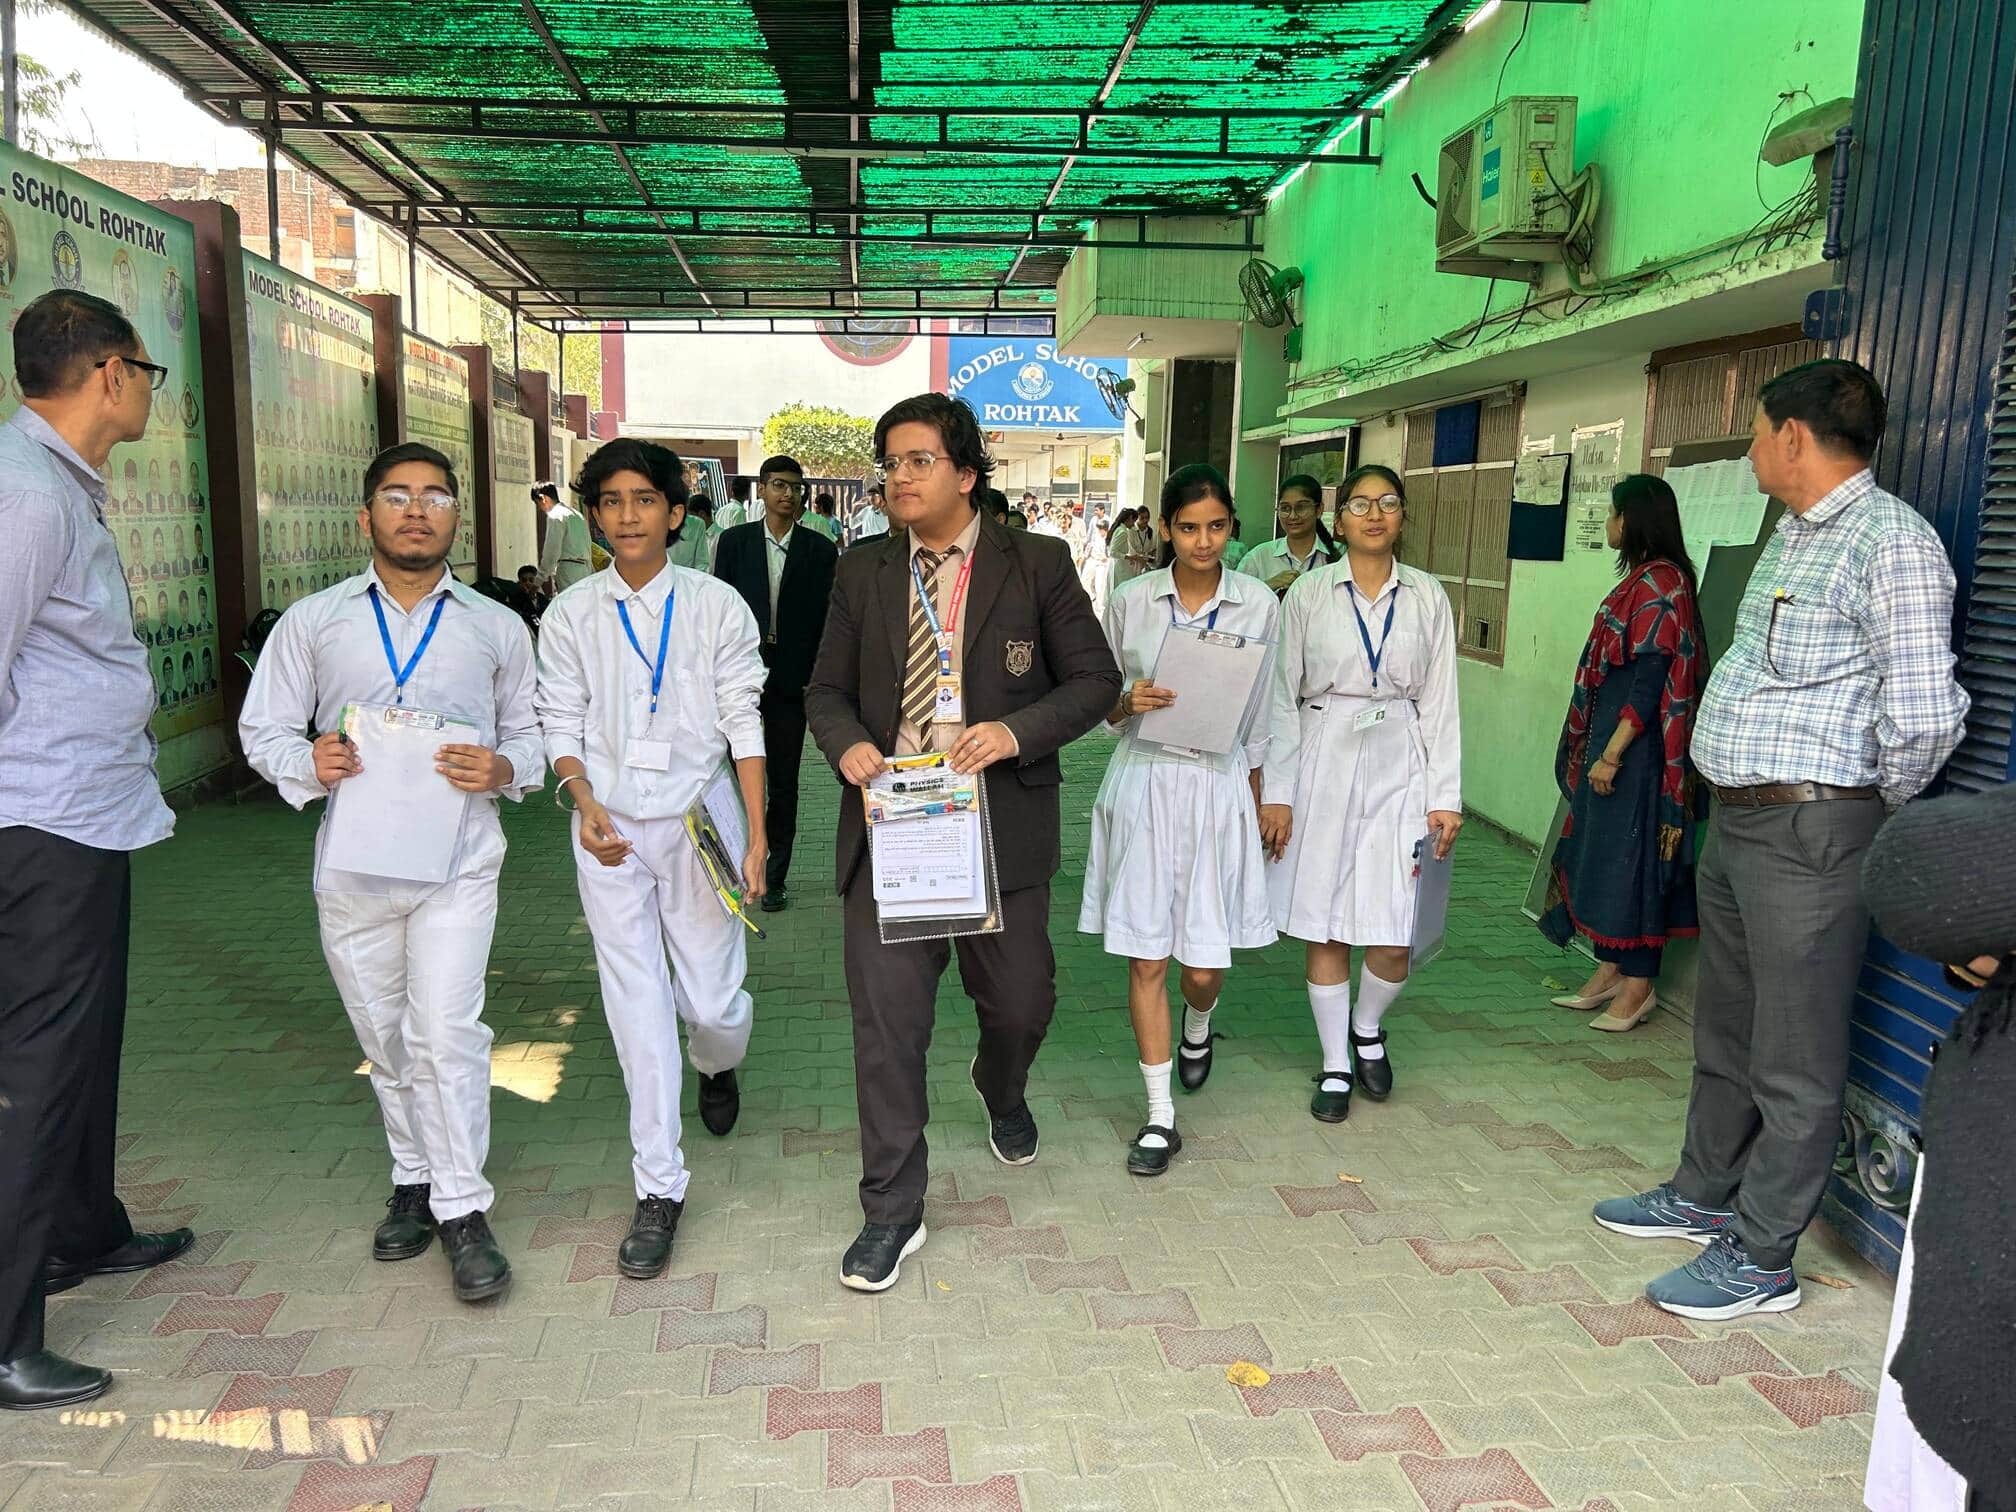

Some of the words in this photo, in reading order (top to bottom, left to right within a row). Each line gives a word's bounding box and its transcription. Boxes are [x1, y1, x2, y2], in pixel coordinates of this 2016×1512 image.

[1482, 167, 1500, 184] Haier
[12, 171, 95, 230] SCHOOL
[99, 207, 168, 256] ROHTAK
[248, 270, 287, 305] MODEL
[288, 287, 326, 321] SCHOOL
[328, 305, 361, 336] ROHTAK
[947, 344, 1024, 400] MODEL
[983, 403, 1080, 423] ROHTAK
[909, 777, 944, 787] PHYSICS
